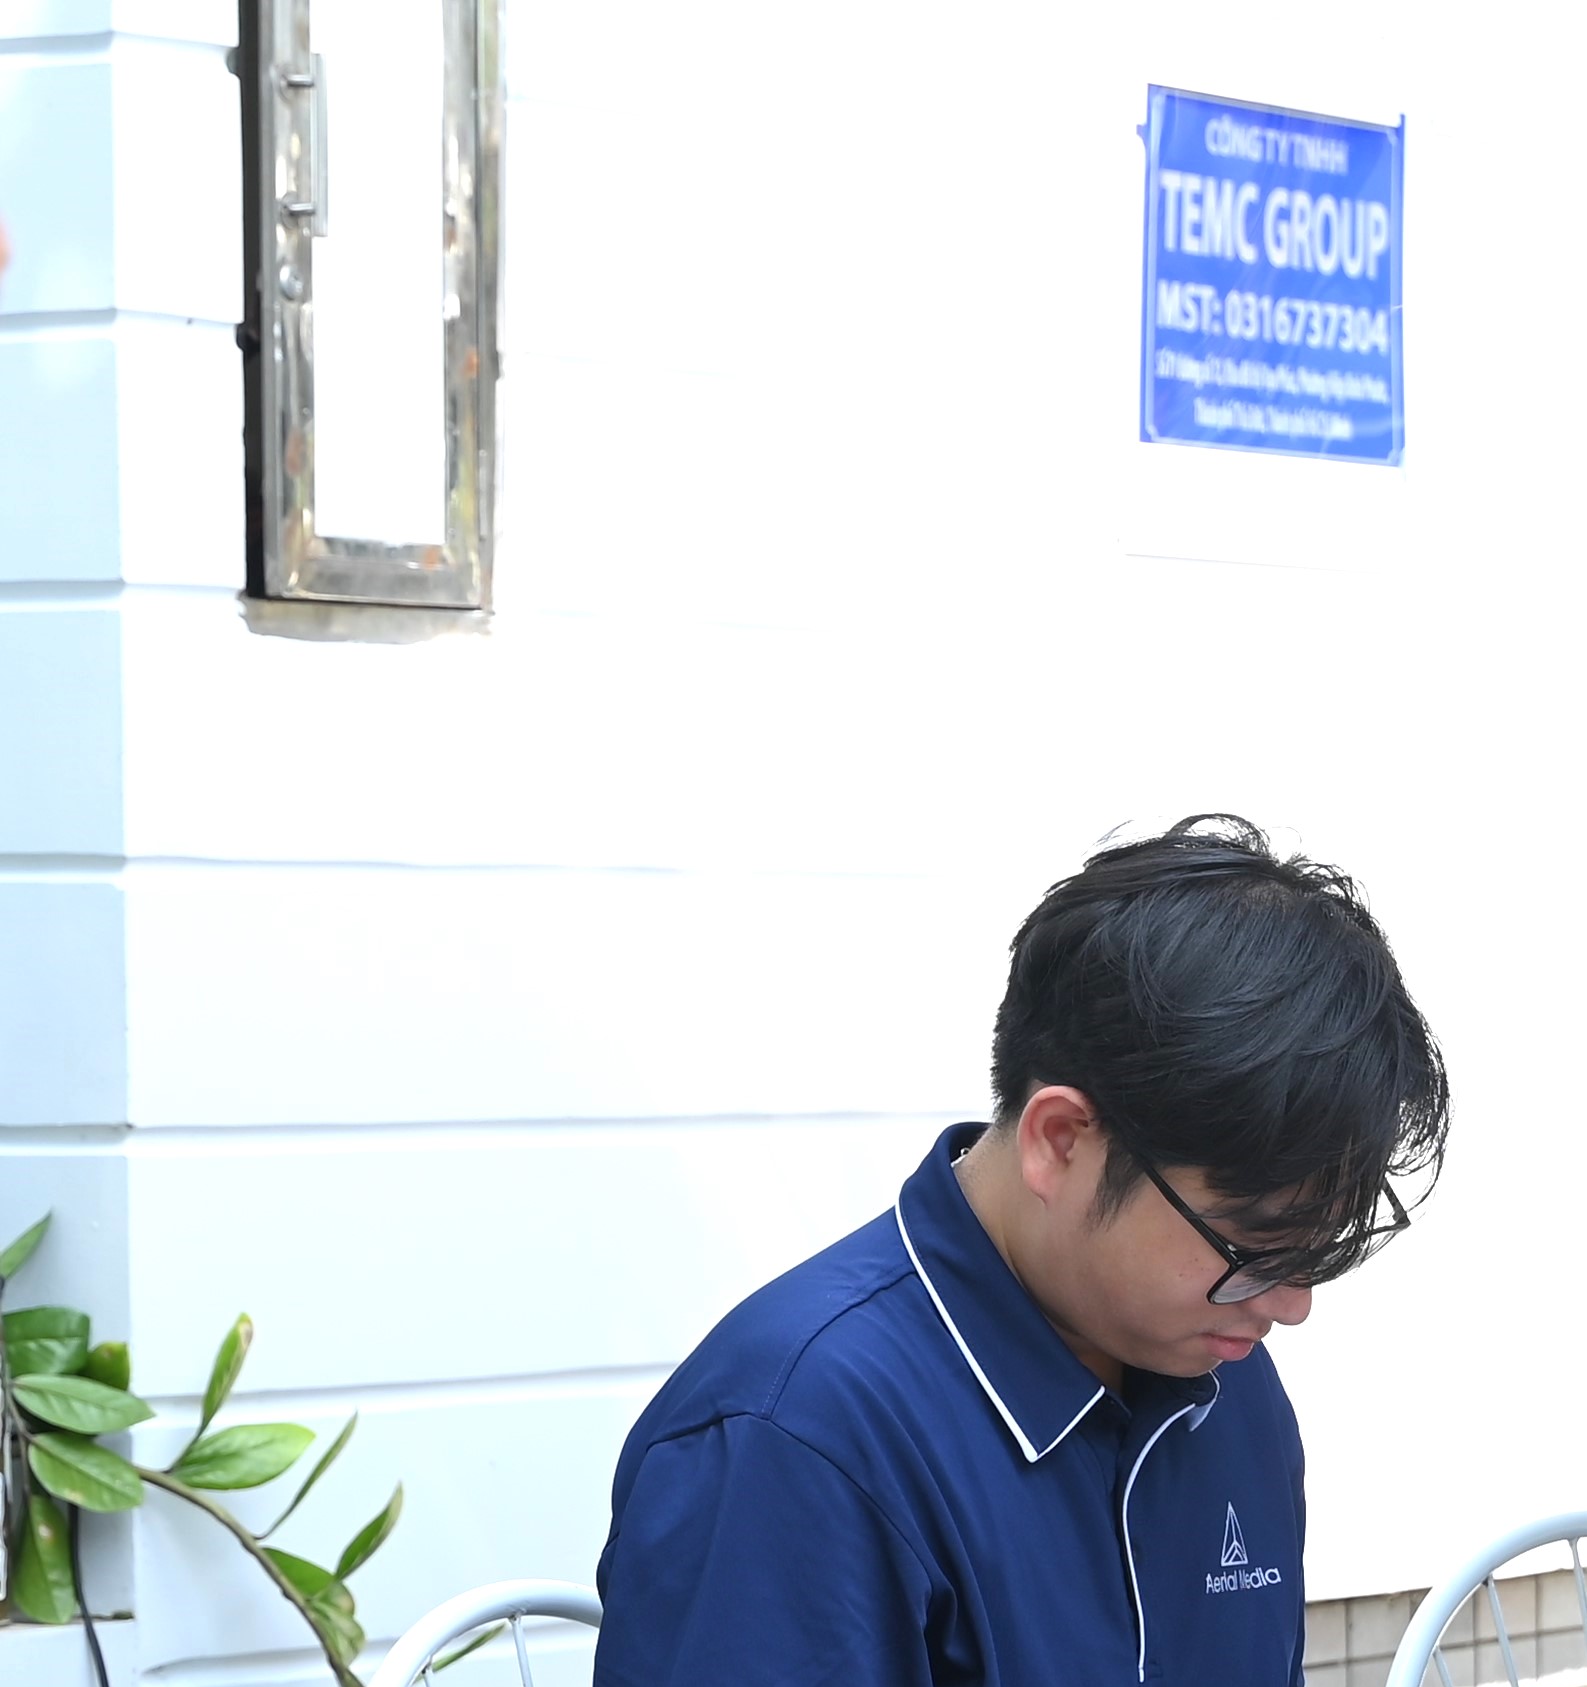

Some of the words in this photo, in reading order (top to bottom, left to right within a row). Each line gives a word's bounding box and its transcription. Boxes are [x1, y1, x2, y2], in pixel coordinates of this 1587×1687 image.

[1159, 168, 1260, 265] TEMC
[1263, 186, 1389, 280] GROUP
[1157, 279, 1222, 336] MST:
[1224, 289, 1388, 355] 0316737304
[1205, 1570, 1238, 1594] Aerial
